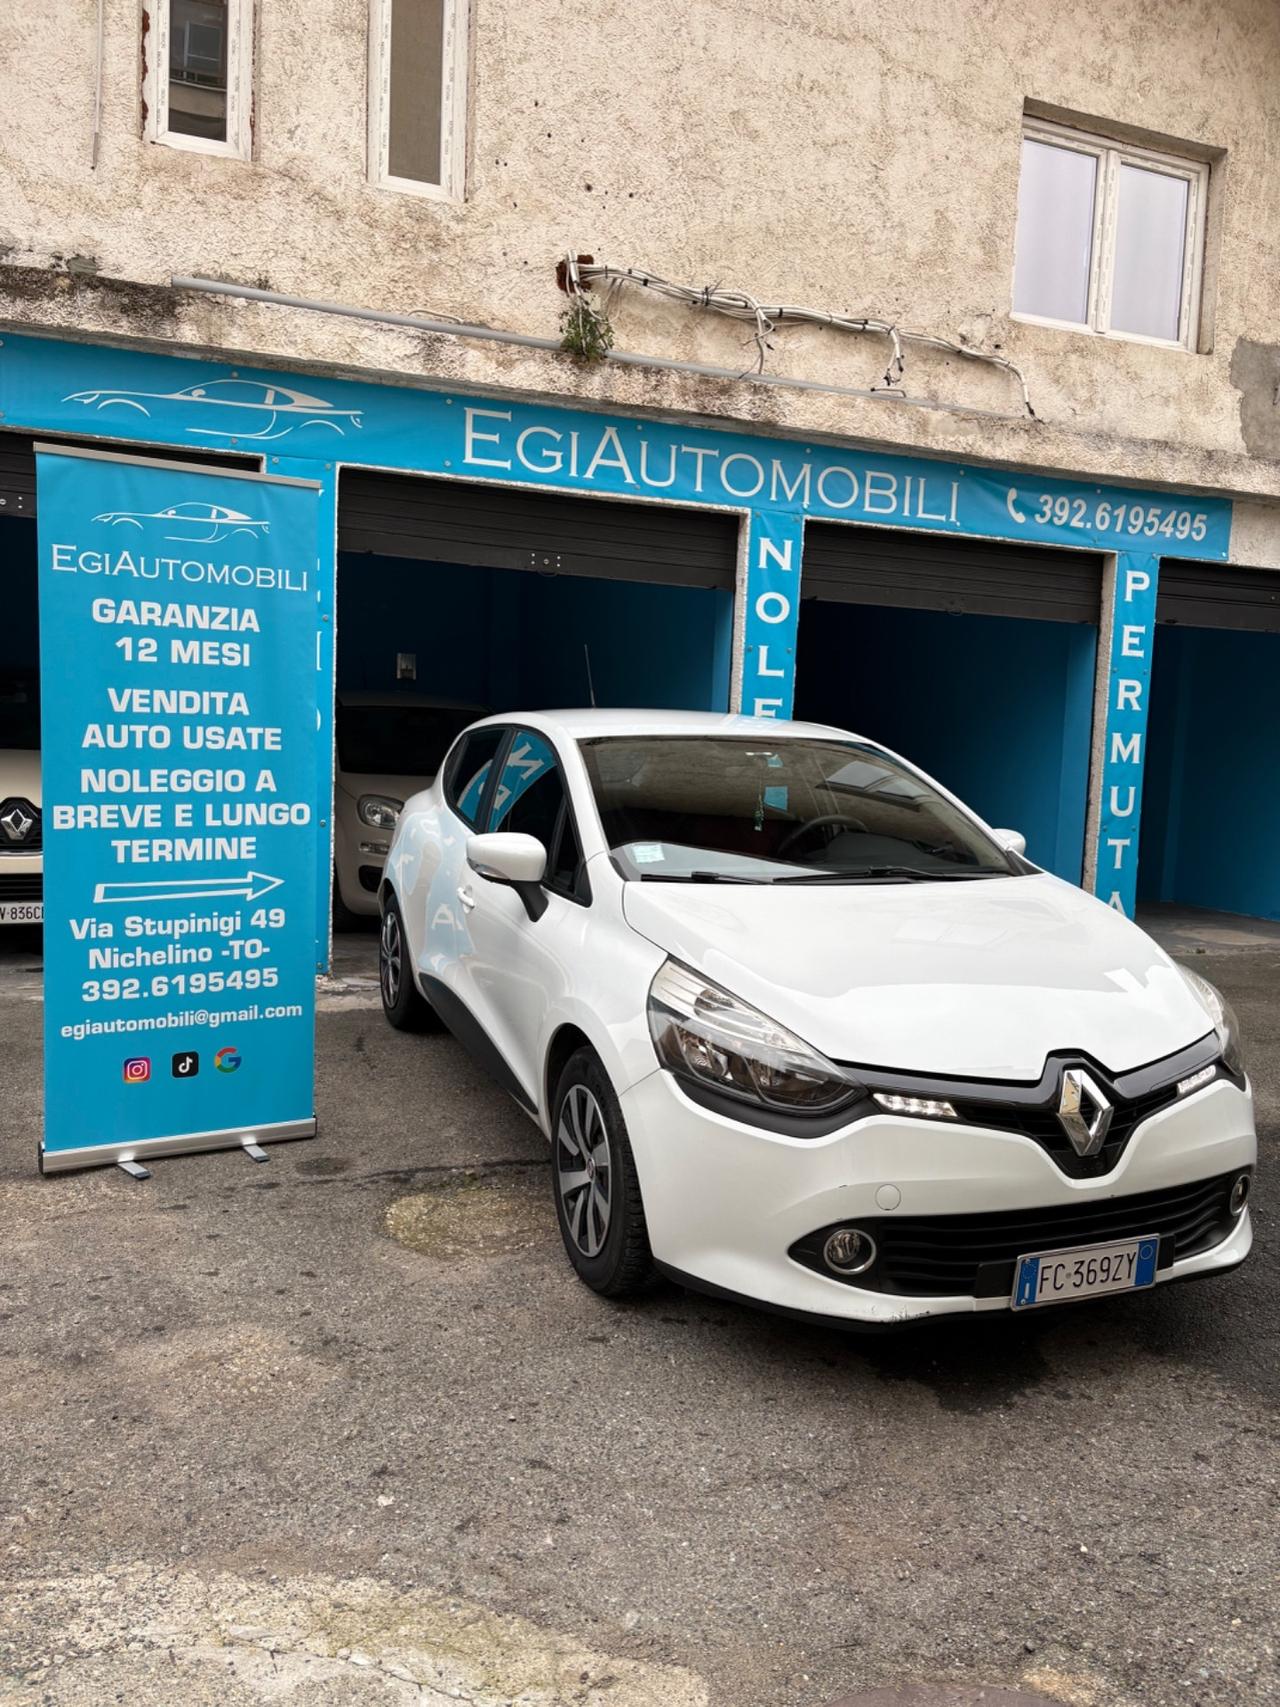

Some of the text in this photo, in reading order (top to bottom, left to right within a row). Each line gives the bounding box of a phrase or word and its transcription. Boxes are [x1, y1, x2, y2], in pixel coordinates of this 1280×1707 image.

[1035, 494, 1208, 542] 392.6195495
[91, 597, 261, 633] GARANZIA
[115, 637, 251, 667] 12 MESI
[107, 687, 251, 716] VENDITA
[81, 723, 283, 751] AUTO USATE
[1106, 570, 1151, 917] PERMUTA
[80, 768, 278, 793] NOLEGGIO A
[52, 802, 312, 830] BREVE E LUNGO
[110, 836, 258, 864] TERMINE
[10, 906, 44, 920] 836C
[69, 908, 286, 940] Via Stupinigi 49
[88, 939, 271, 970] Nichelino -TO-
[81, 966, 280, 1003] 392.6195495
[60, 1003, 303, 1040] egiautomobili@gmail.com
